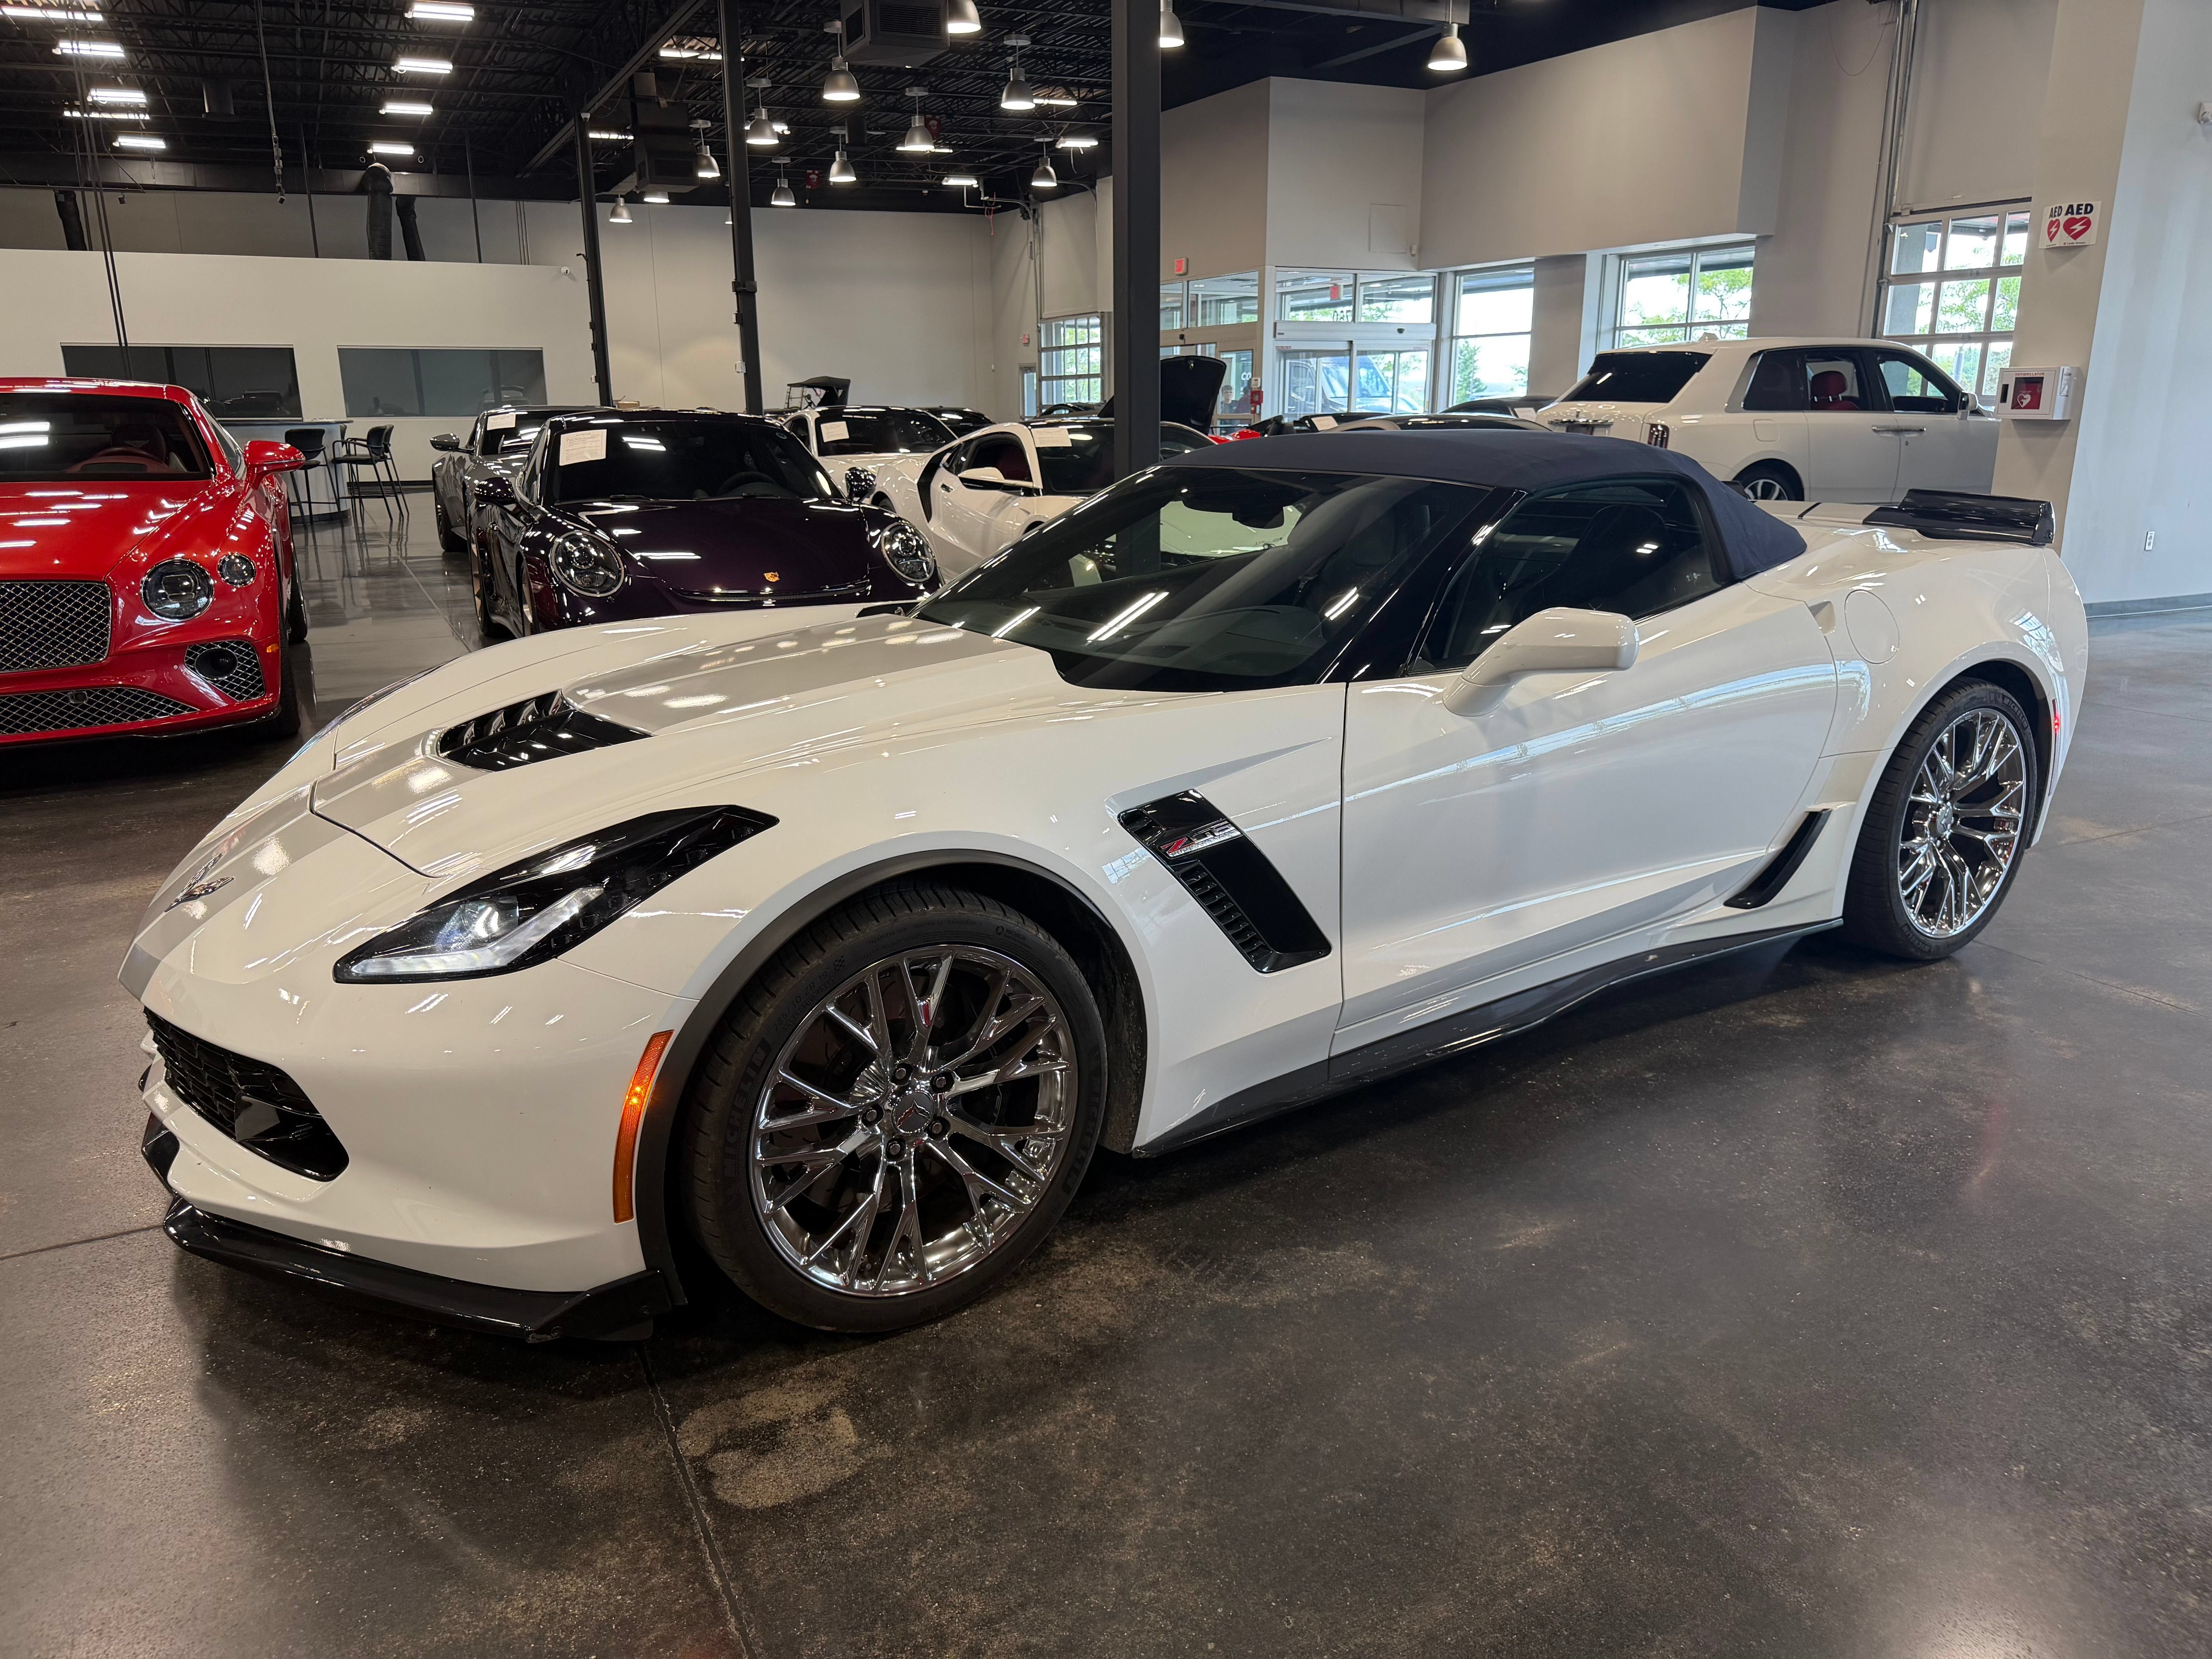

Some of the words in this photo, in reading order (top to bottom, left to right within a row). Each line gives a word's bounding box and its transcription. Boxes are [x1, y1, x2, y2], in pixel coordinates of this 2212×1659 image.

[2049, 206, 2063, 219] AED
[2065, 203, 2094, 216] AED
[2002, 698, 2028, 728] MICHELIN
[1161, 822, 1235, 854] Z06
[775, 996, 801, 1032] 285/30
[804, 982, 815, 996] ZR
[818, 971, 827, 982] 19
[723, 1046, 767, 1177] MICHELIN
[1066, 1077, 1101, 1189] MICHELIN
